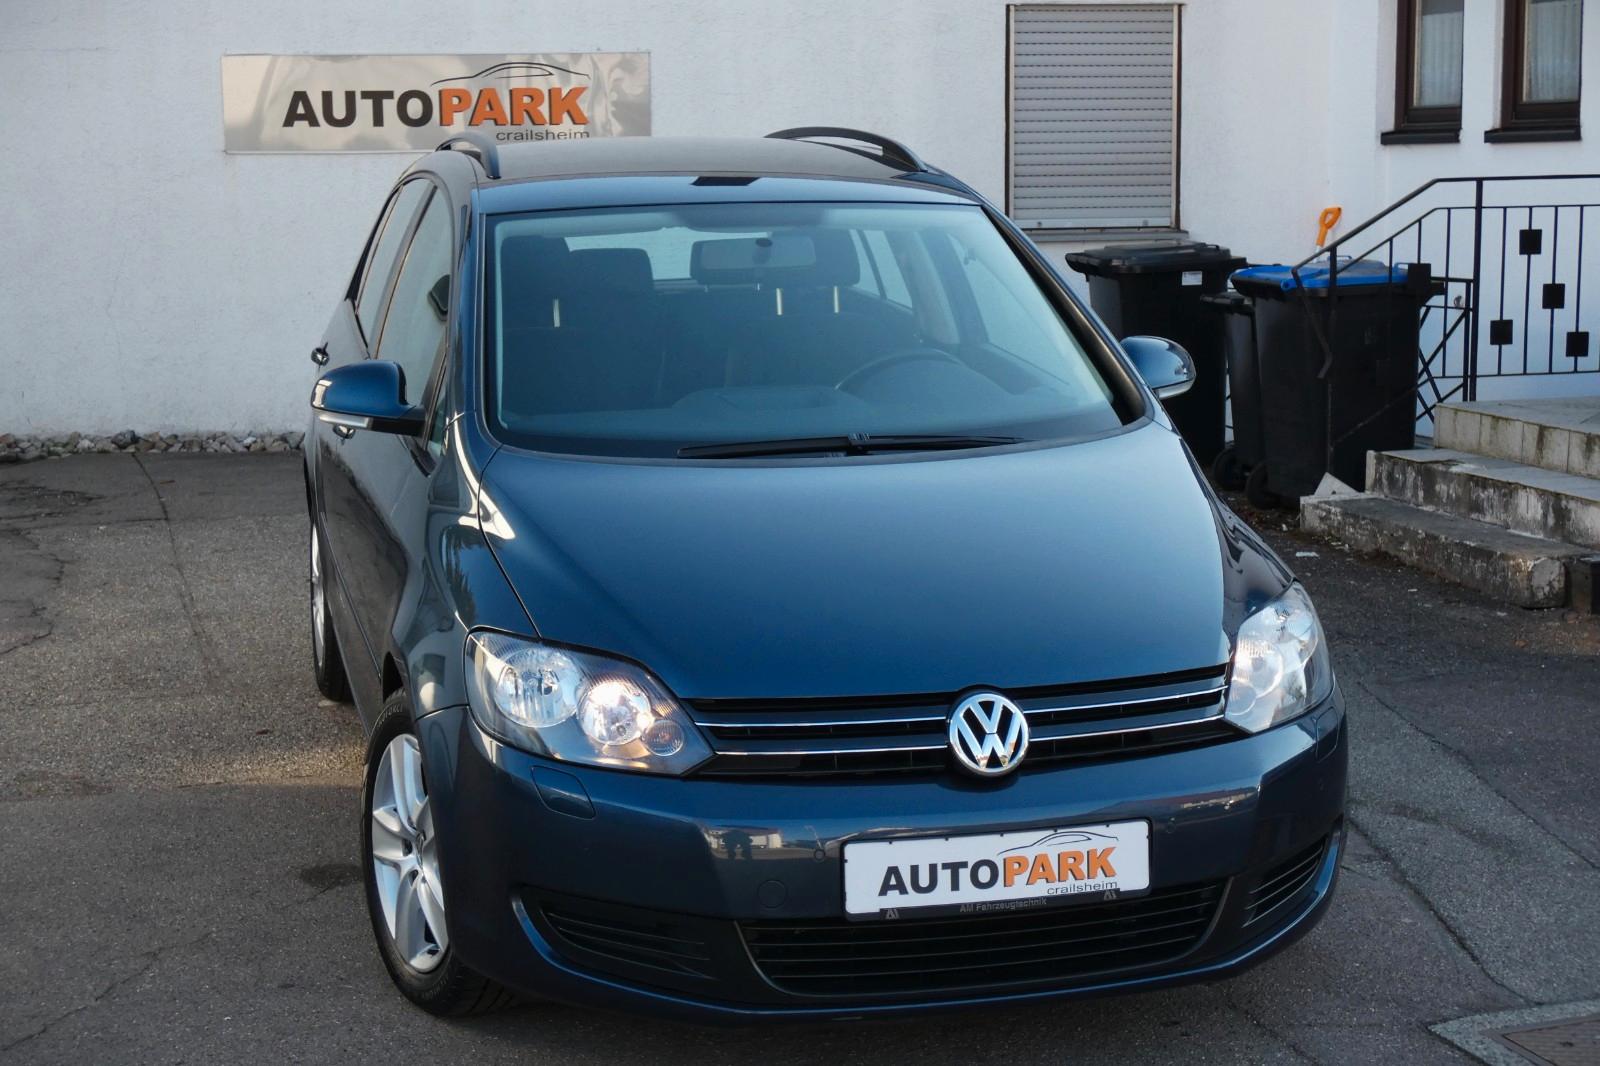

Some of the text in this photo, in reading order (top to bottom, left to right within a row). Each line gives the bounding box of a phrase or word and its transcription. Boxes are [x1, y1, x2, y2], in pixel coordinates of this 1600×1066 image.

[282, 86, 590, 127] AUTOPARK
[496, 129, 590, 141] crailsheim
[878, 846, 1117, 896] AUTOPARK
[1046, 881, 1118, 895] crailsheim
